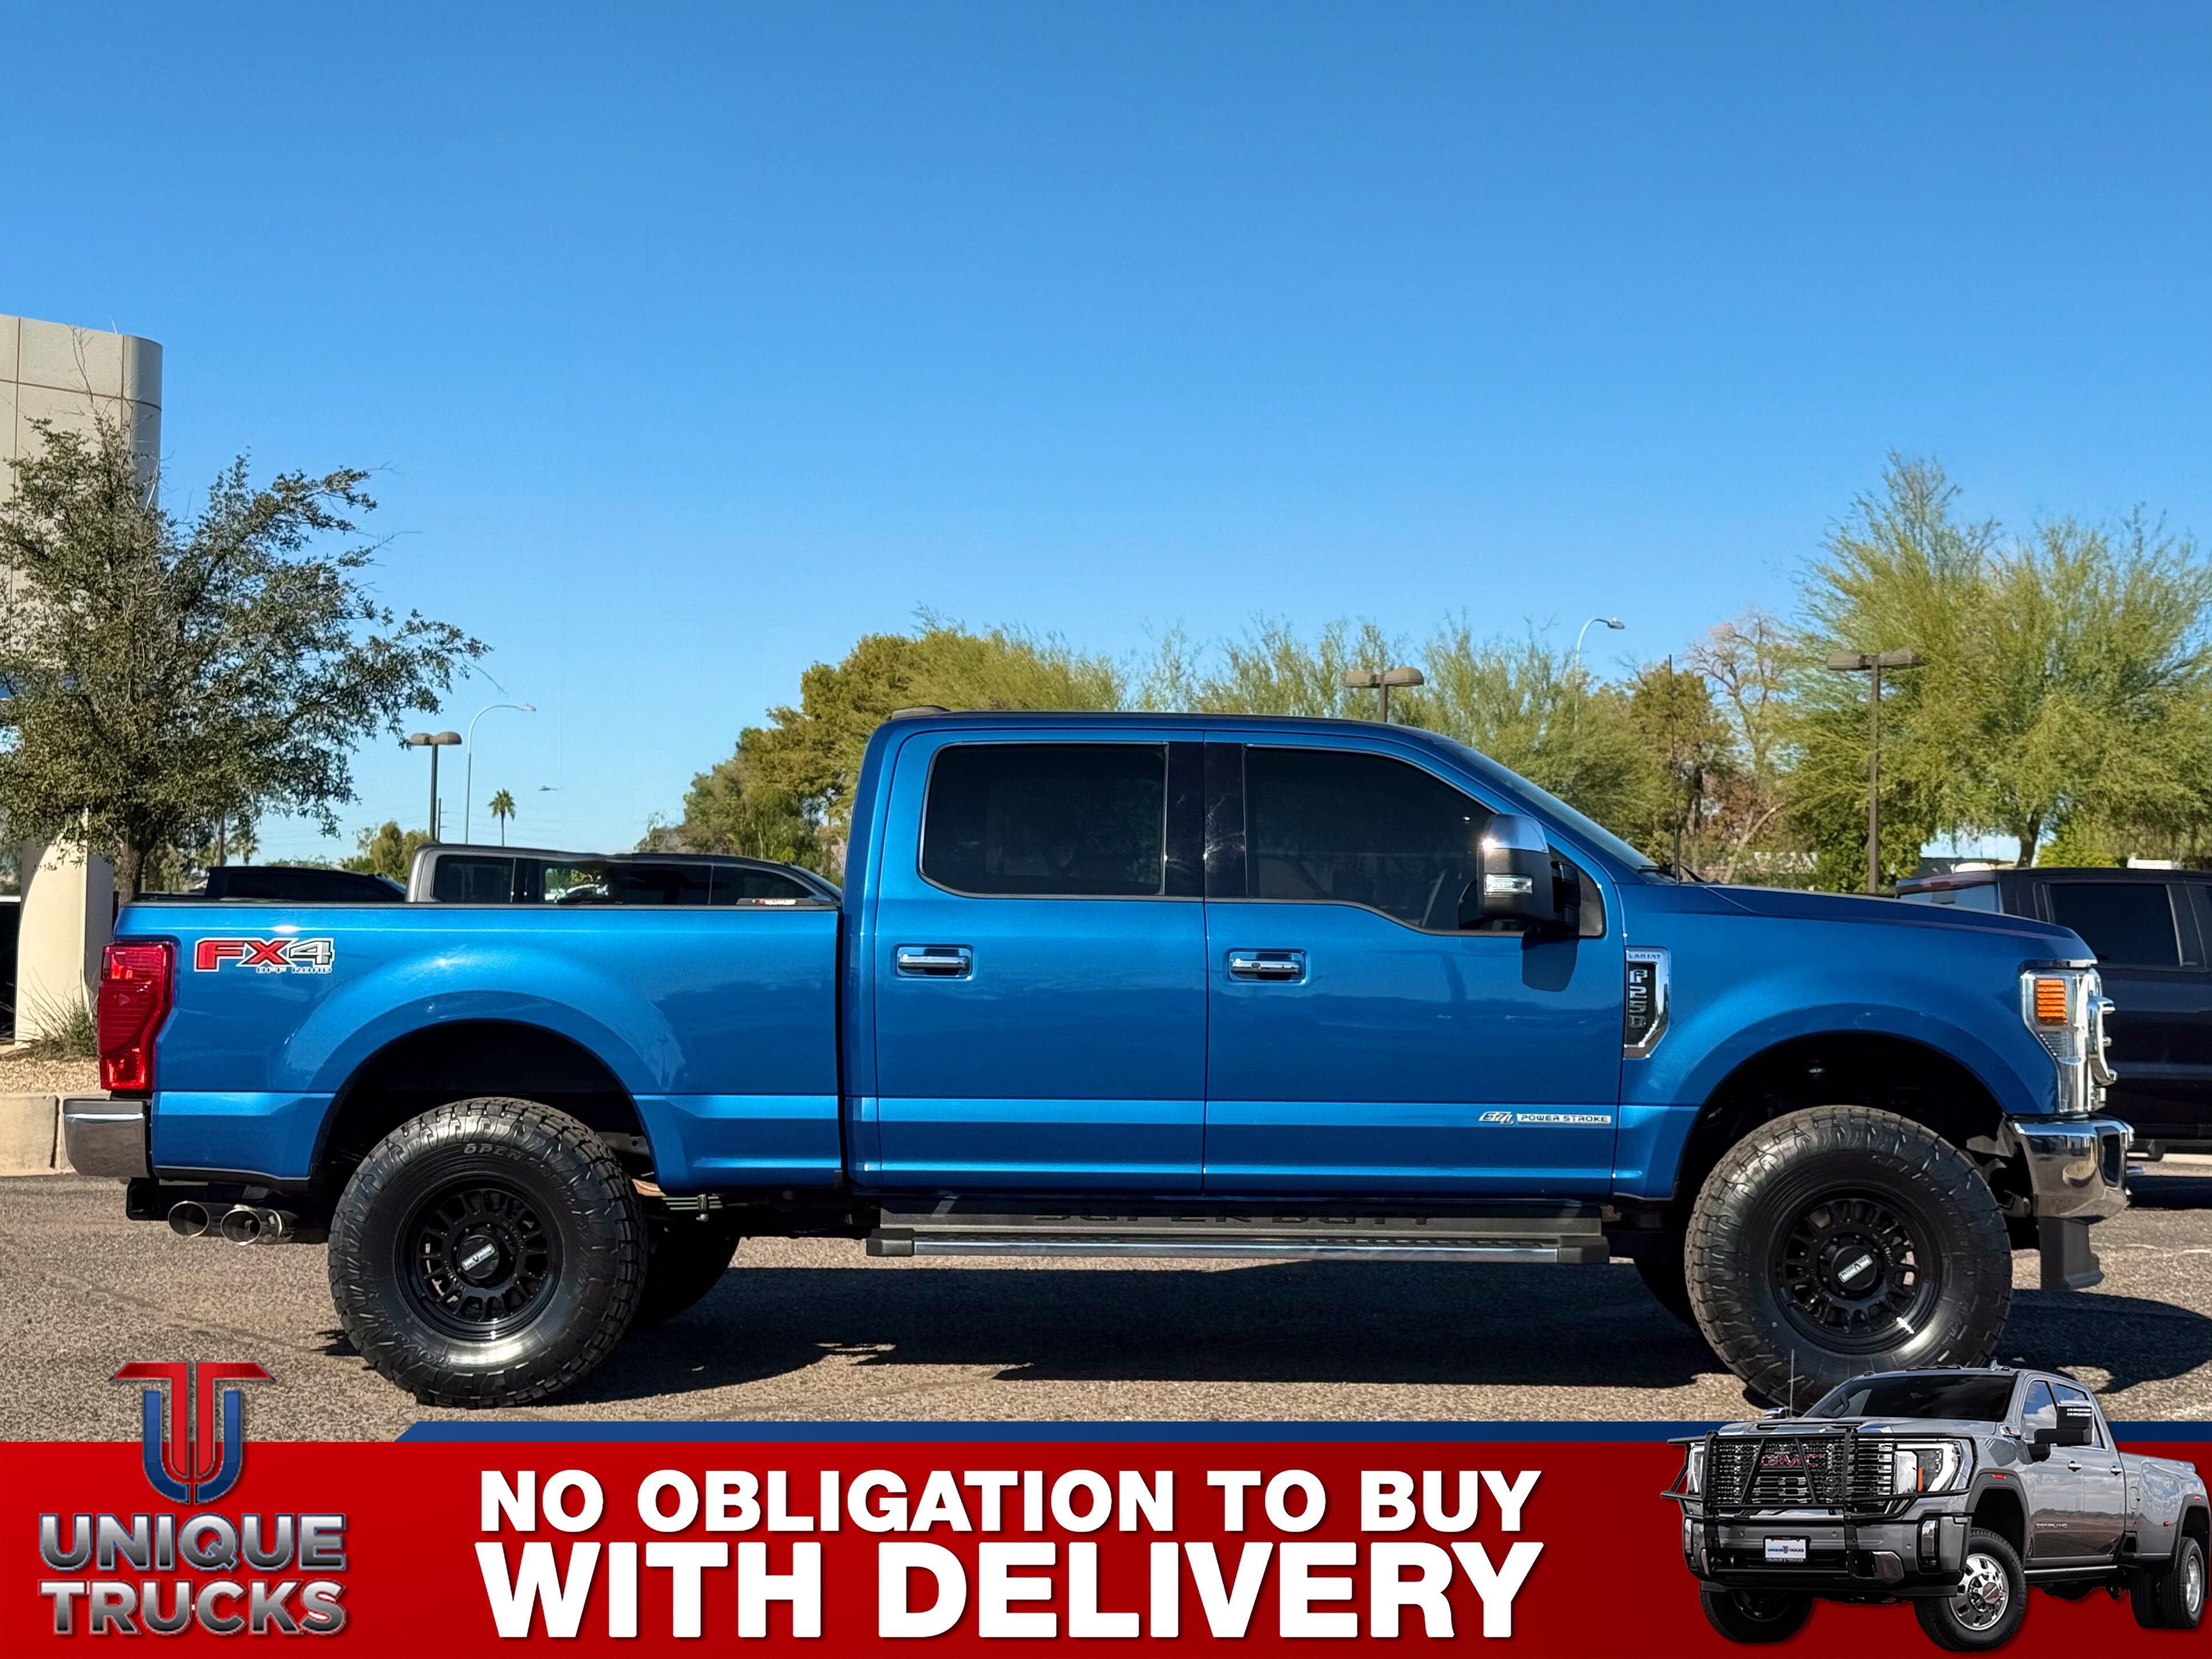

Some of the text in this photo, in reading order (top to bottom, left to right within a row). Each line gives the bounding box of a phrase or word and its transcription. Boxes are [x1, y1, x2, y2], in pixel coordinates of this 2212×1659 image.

[194, 938, 335, 973] FX4
[1520, 1114, 1559, 1122] POWER
[1563, 1114, 1609, 1123] STROKE
[464, 1143, 523, 1161] OPEN
